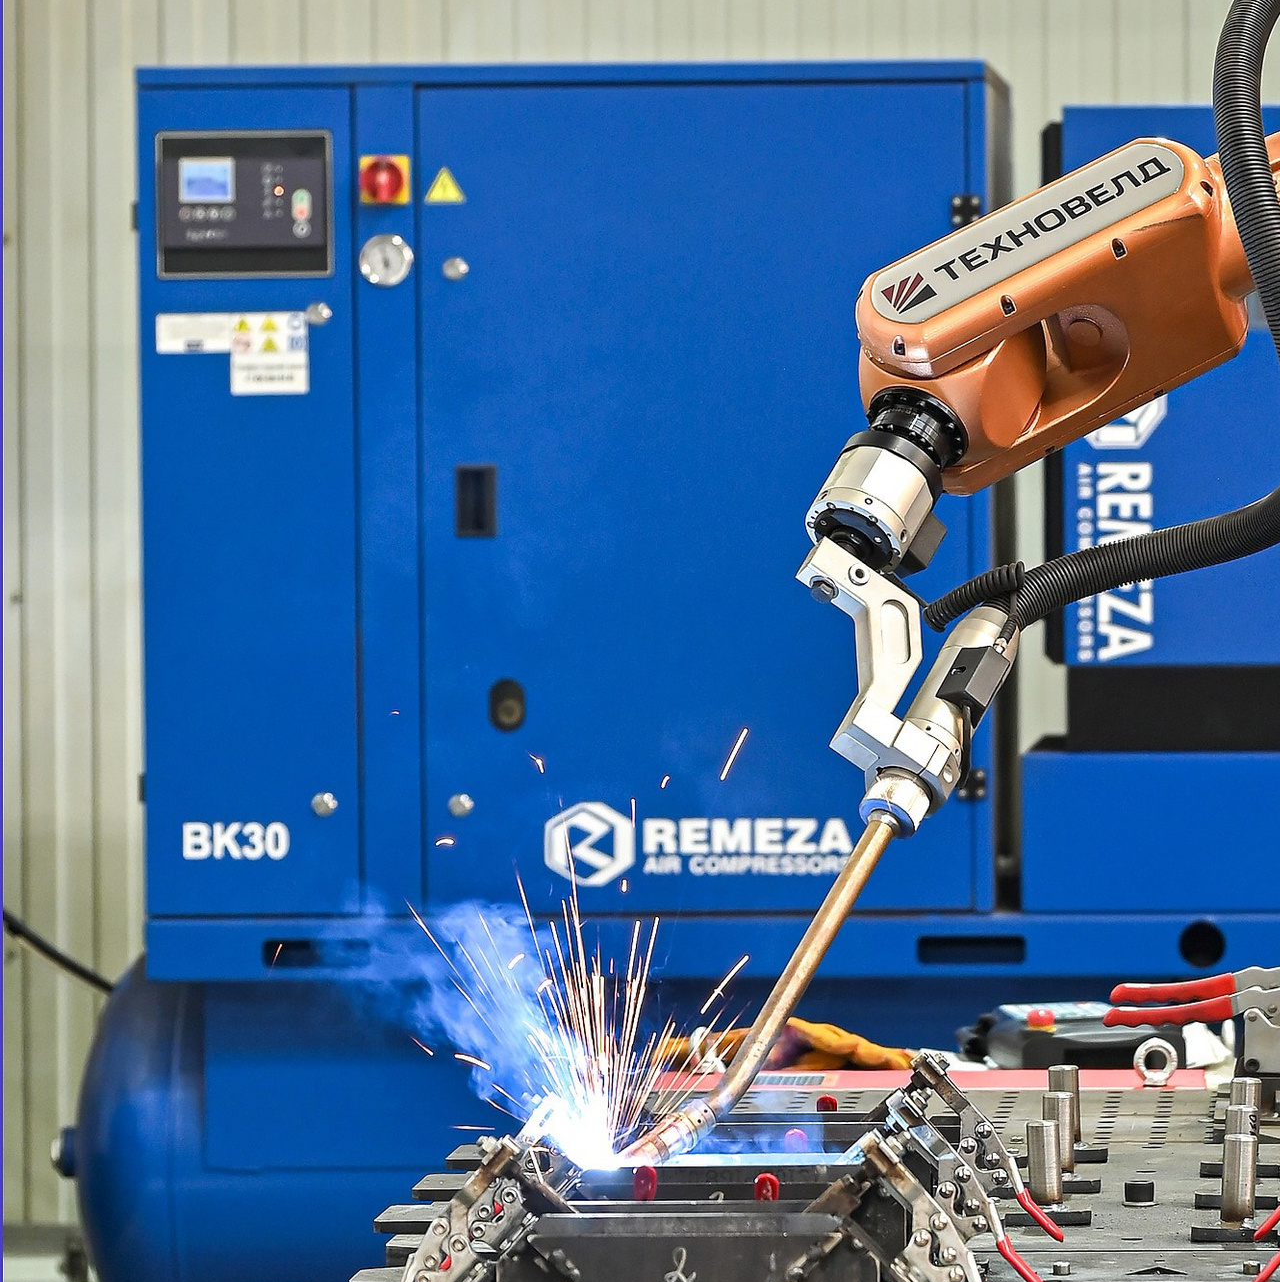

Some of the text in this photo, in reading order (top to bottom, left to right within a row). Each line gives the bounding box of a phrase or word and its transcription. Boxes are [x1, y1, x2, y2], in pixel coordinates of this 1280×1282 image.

[934, 156, 1171, 281] ТЕХНОВЕЛД
[182, 821, 290, 860] BK30
[643, 818, 853, 854] REMEZA
[643, 854, 682, 876] AIR
